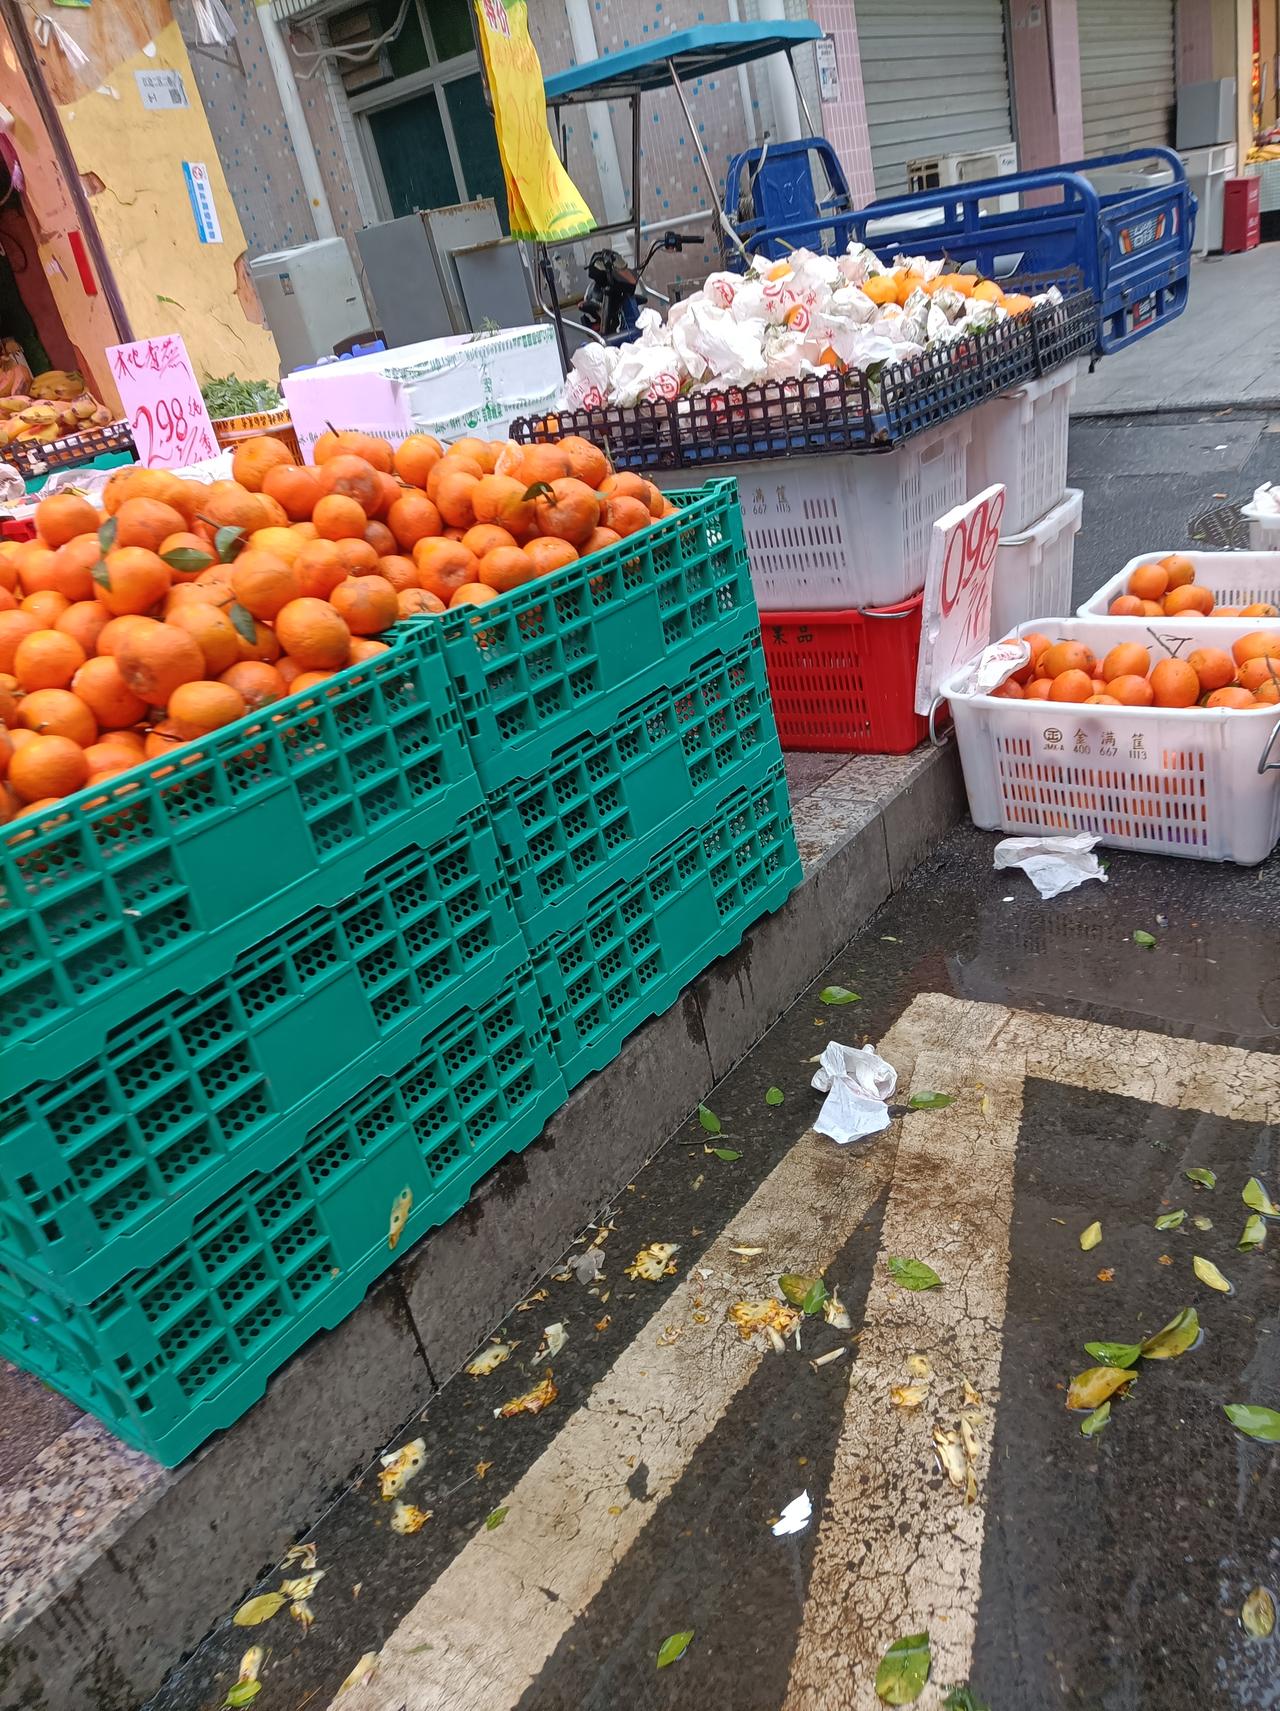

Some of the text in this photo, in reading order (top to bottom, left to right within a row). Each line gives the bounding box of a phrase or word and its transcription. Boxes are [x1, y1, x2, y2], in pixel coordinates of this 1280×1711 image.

[772, 624, 813, 645] 果品
[1073, 728, 1145, 750] 金满筐
[1073, 745, 1091, 755] 400
[1099, 747, 1119, 757] 667
[1128, 750, 1148, 760] 1113
